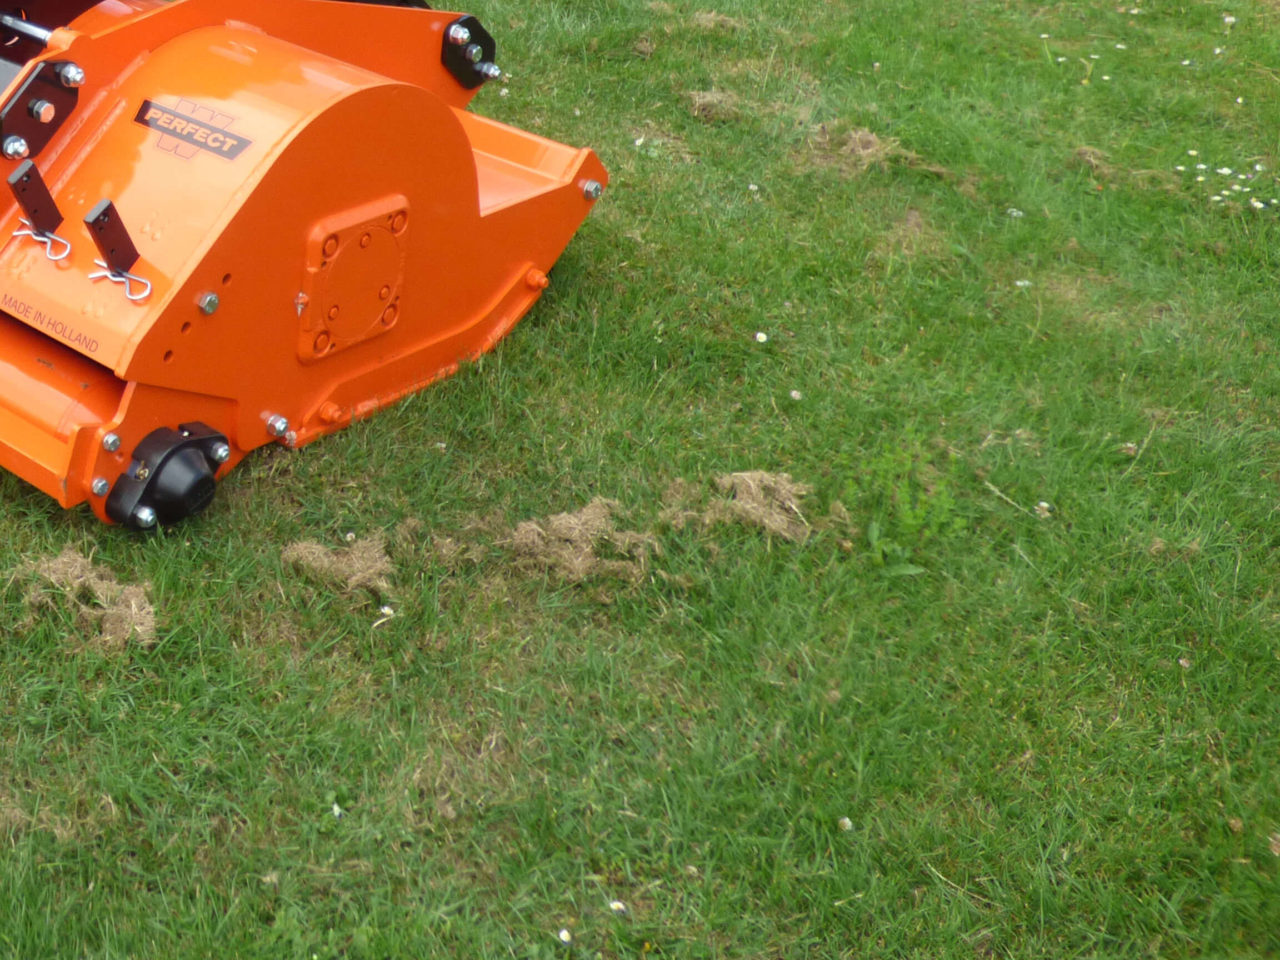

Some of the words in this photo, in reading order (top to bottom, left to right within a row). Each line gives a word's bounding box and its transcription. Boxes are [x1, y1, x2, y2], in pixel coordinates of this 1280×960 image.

[144, 107, 237, 151] PERFECT
[1, 293, 33, 319] MADE
[33, 310, 46, 326] IN
[46, 317, 99, 353] HOLLAND
